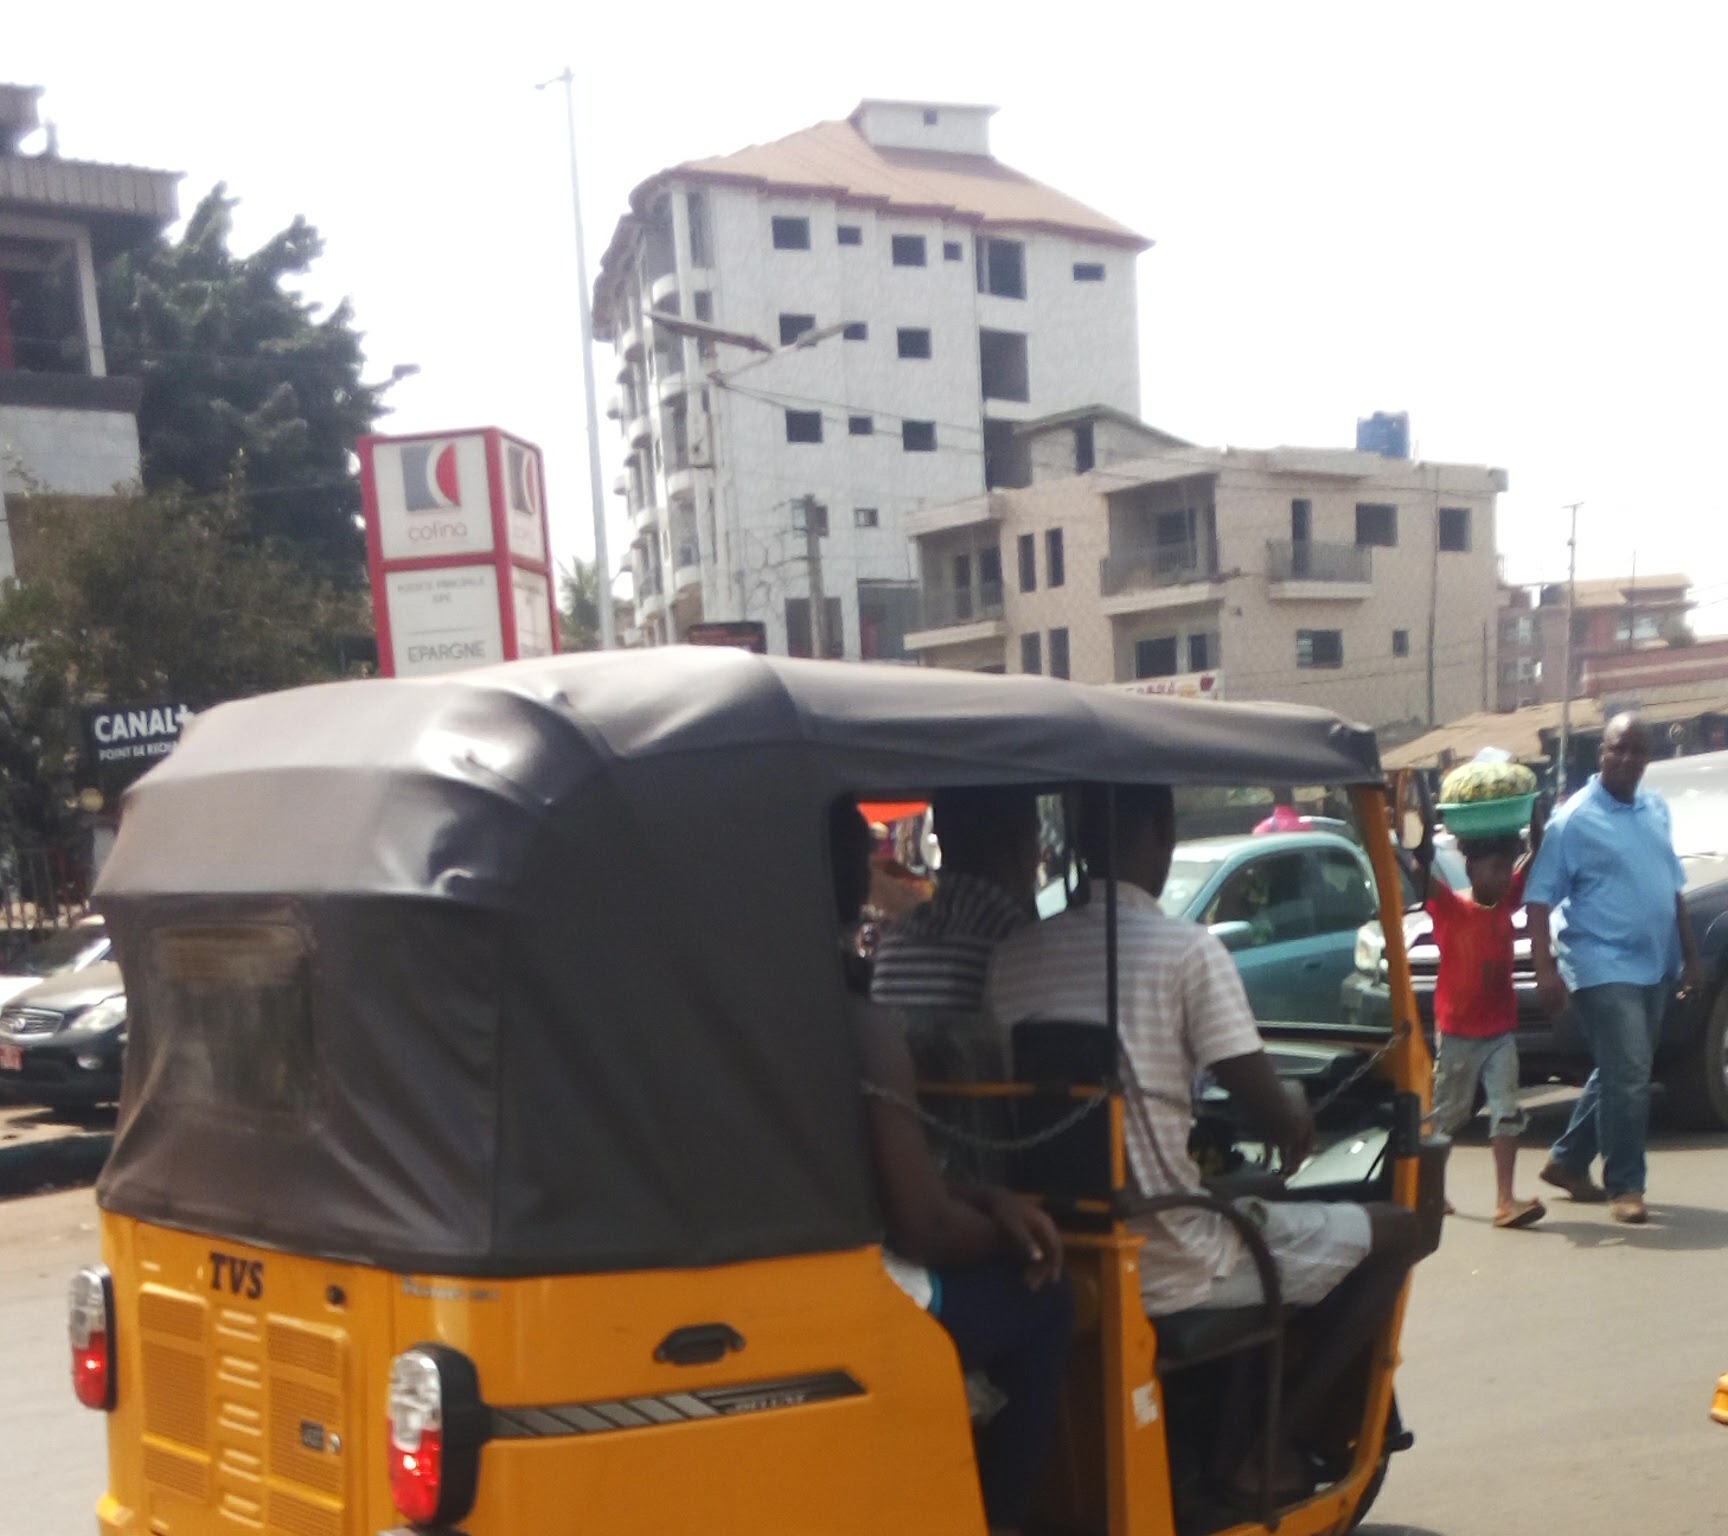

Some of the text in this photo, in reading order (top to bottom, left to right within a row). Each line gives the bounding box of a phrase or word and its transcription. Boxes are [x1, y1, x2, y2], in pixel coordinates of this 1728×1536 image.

[408, 639, 486, 662] EPARGNE
[95, 704, 195, 743] CANAL+
[209, 1250, 265, 1300] TVS
